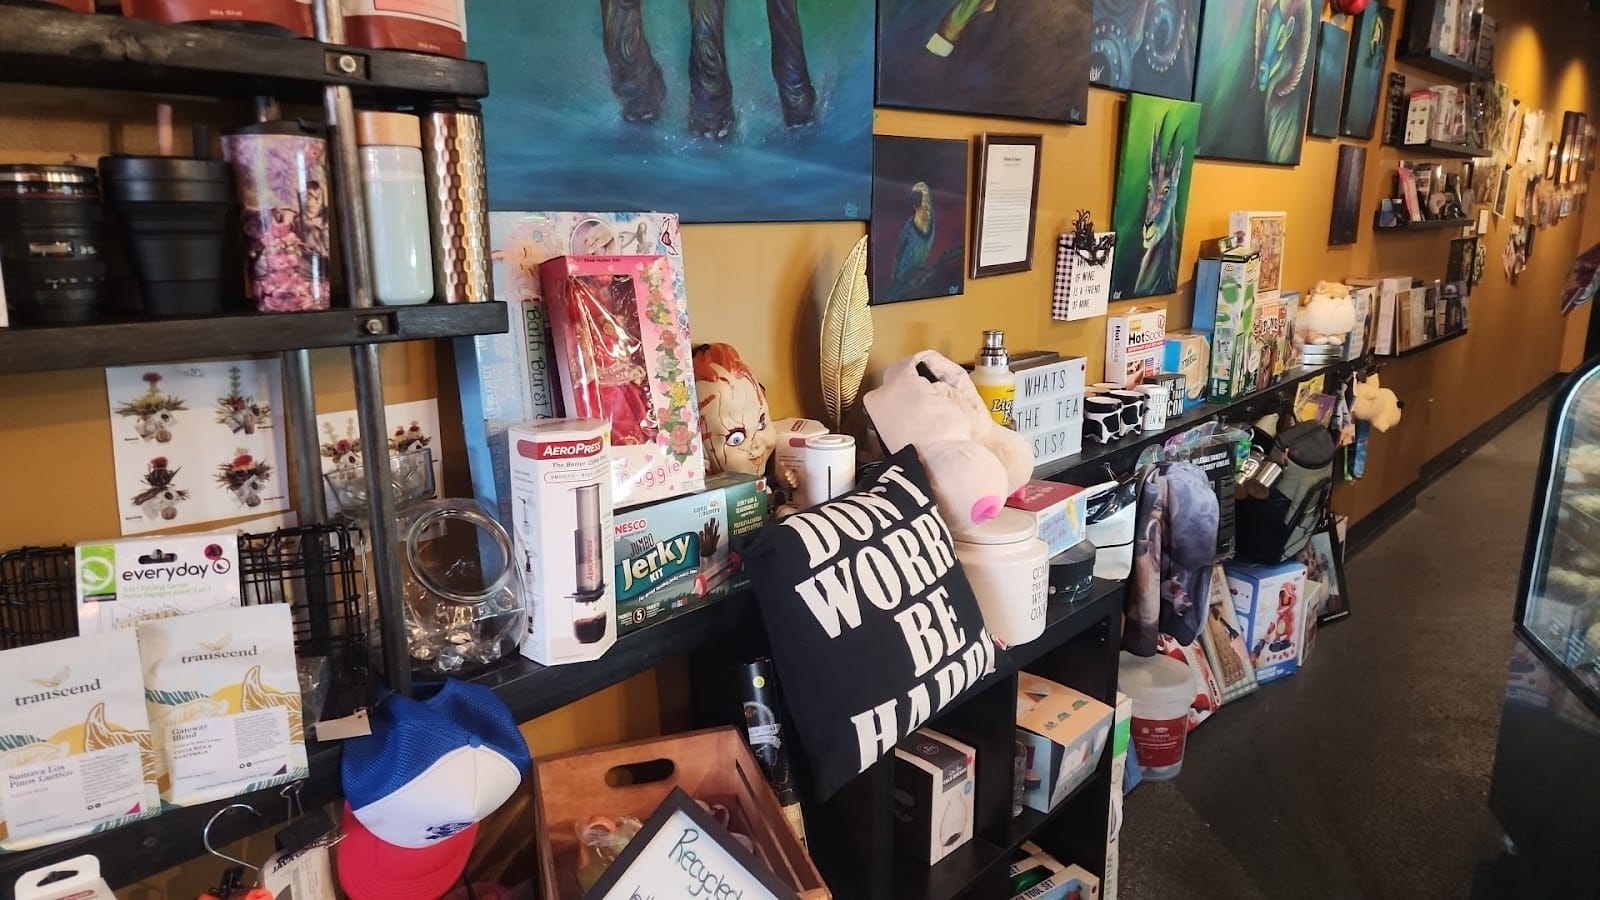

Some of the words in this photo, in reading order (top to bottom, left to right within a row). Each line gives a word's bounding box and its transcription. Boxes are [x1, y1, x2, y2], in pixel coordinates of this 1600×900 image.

[1082, 270, 1095, 281] WINE
[1085, 284, 1101, 294] FRIEND
[1072, 300, 1078, 310] OF
[1079, 299, 1090, 308] MINE
[526, 306, 545, 351] Bath
[531, 357, 550, 407] Burst
[1024, 369, 1066, 398] WHATS
[1017, 407, 1040, 433] THE
[1057, 397, 1079, 421] TEA
[1167, 399, 1185, 417] CON
[1033, 432, 1066, 458] SIS?
[614, 519, 647, 535] NESCO
[779, 465, 930, 569] DON'T
[630, 533, 655, 558] JUMBO
[122, 561, 209, 582] everyday
[622, 535, 690, 592] Jerky
[795, 504, 958, 638] WORR
[1033, 561, 1049, 580] COM
[649, 568, 664, 583] KIT
[894, 586, 967, 678] BE
[180, 645, 258, 665] transcend
[15, 678, 102, 706] transcend
[172, 724, 208, 736] Gateway
[173, 732, 197, 742] Blend
[8, 769, 45, 782] Sumava
[48, 764, 65, 774] Los
[9, 778, 36, 790] Pinos
[668, 828, 744, 900] Recycled
[1023, 886, 1045, 899] TOOL
[1041, 879, 1057, 891] SET
